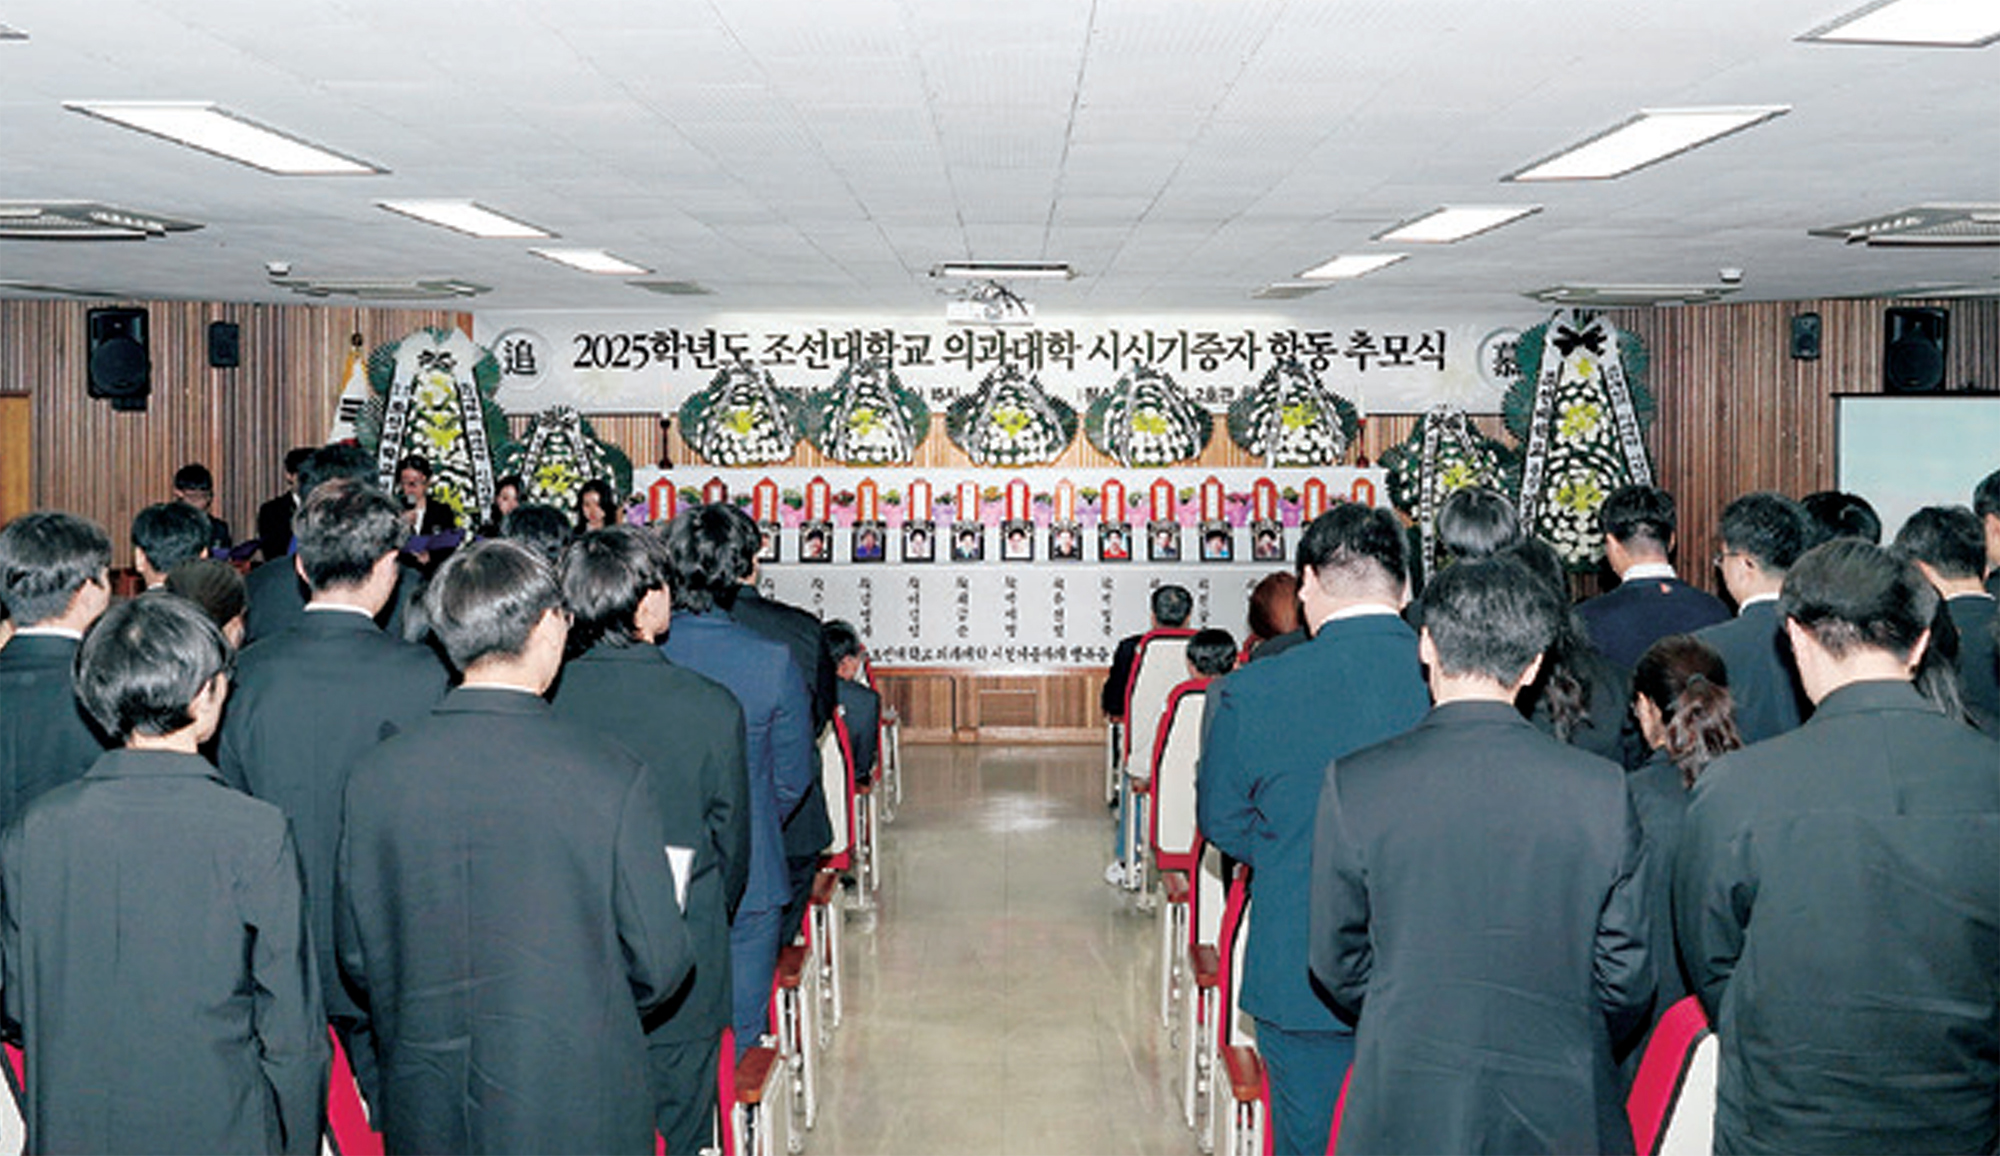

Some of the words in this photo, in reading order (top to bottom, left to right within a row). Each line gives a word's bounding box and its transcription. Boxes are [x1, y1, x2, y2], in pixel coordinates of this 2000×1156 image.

[503, 340, 538, 375] 追
[573, 328, 753, 371] 2025학년도
[759, 328, 935, 371] 조선대학교
[942, 328, 1082, 372] 의과대학
[1087, 329, 1262, 372] 시신기증자
[1267, 330, 1338, 372] 합동
[1343, 329, 1447, 372] 추모식
